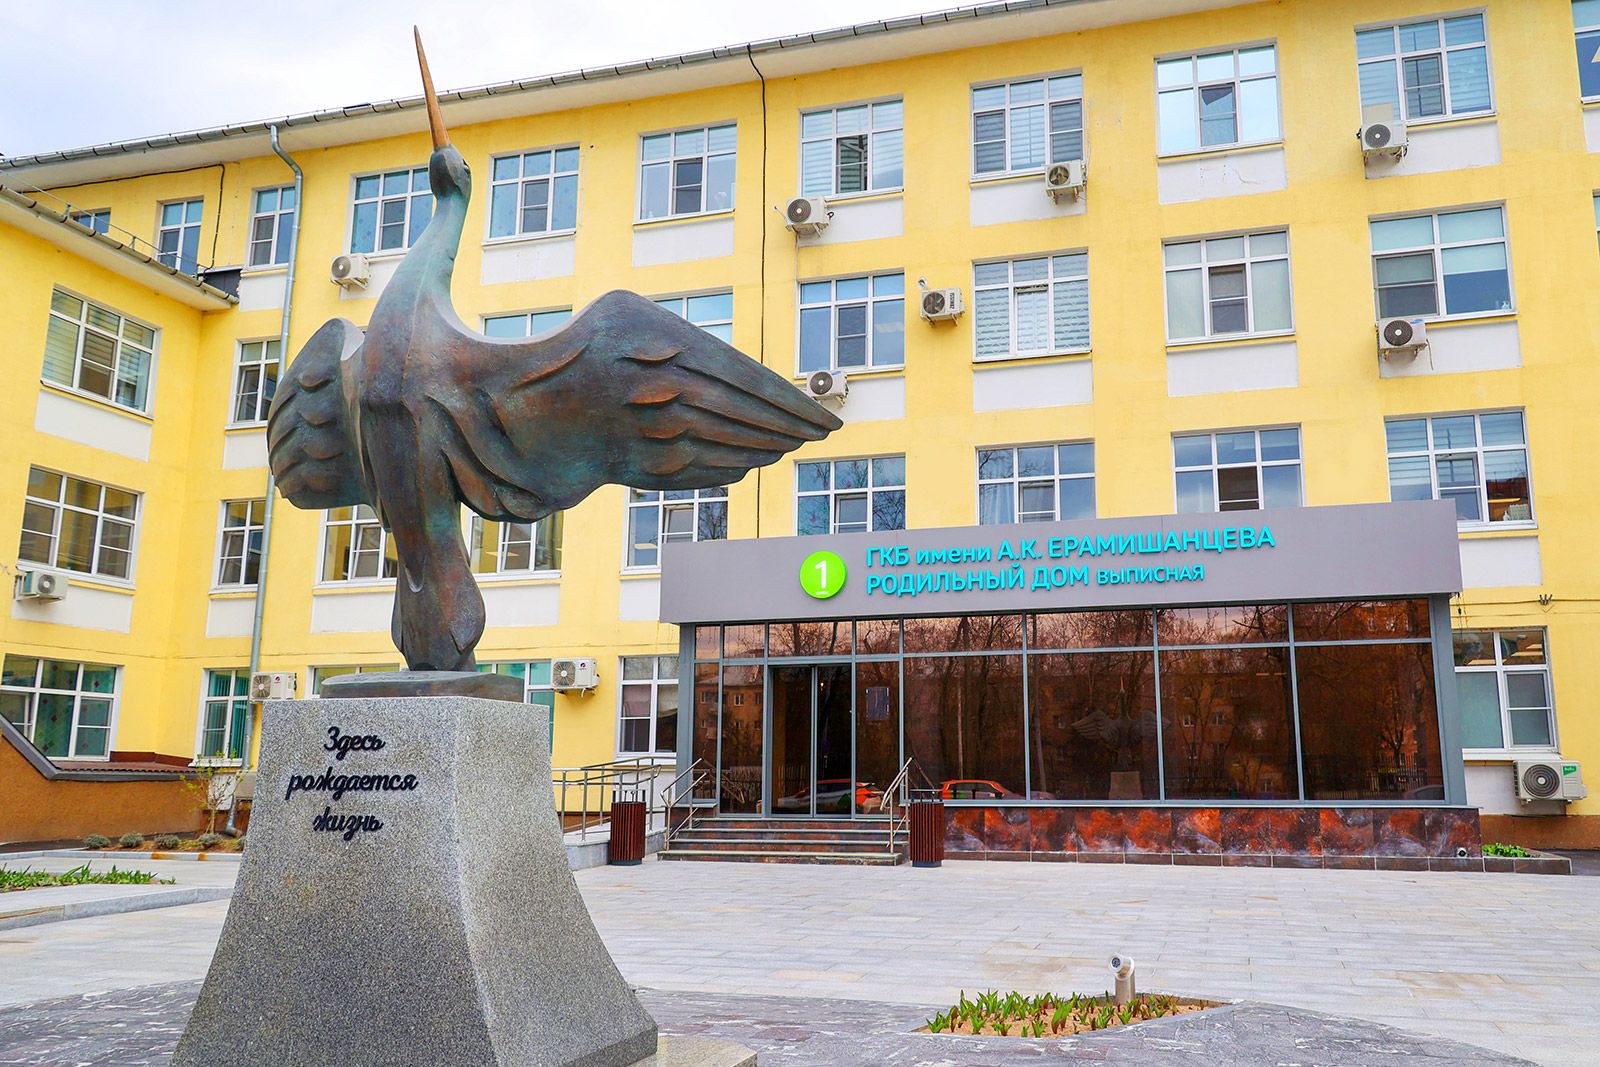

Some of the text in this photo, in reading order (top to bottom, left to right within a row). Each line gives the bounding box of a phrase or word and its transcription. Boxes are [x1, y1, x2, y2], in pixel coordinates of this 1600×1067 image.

[866, 526, 1276, 568] ГКБ имени А.К. ЕРАМИШАНЦЕВА
[815, 560, 827, 589] 1
[866, 563, 1025, 597] РОДИЛЬНЫЙ
[1031, 565, 1090, 591] ДОМ
[323, 726, 386, 761] Здесь
[284, 766, 419, 801] рождается
[312, 806, 384, 841] жизнь
